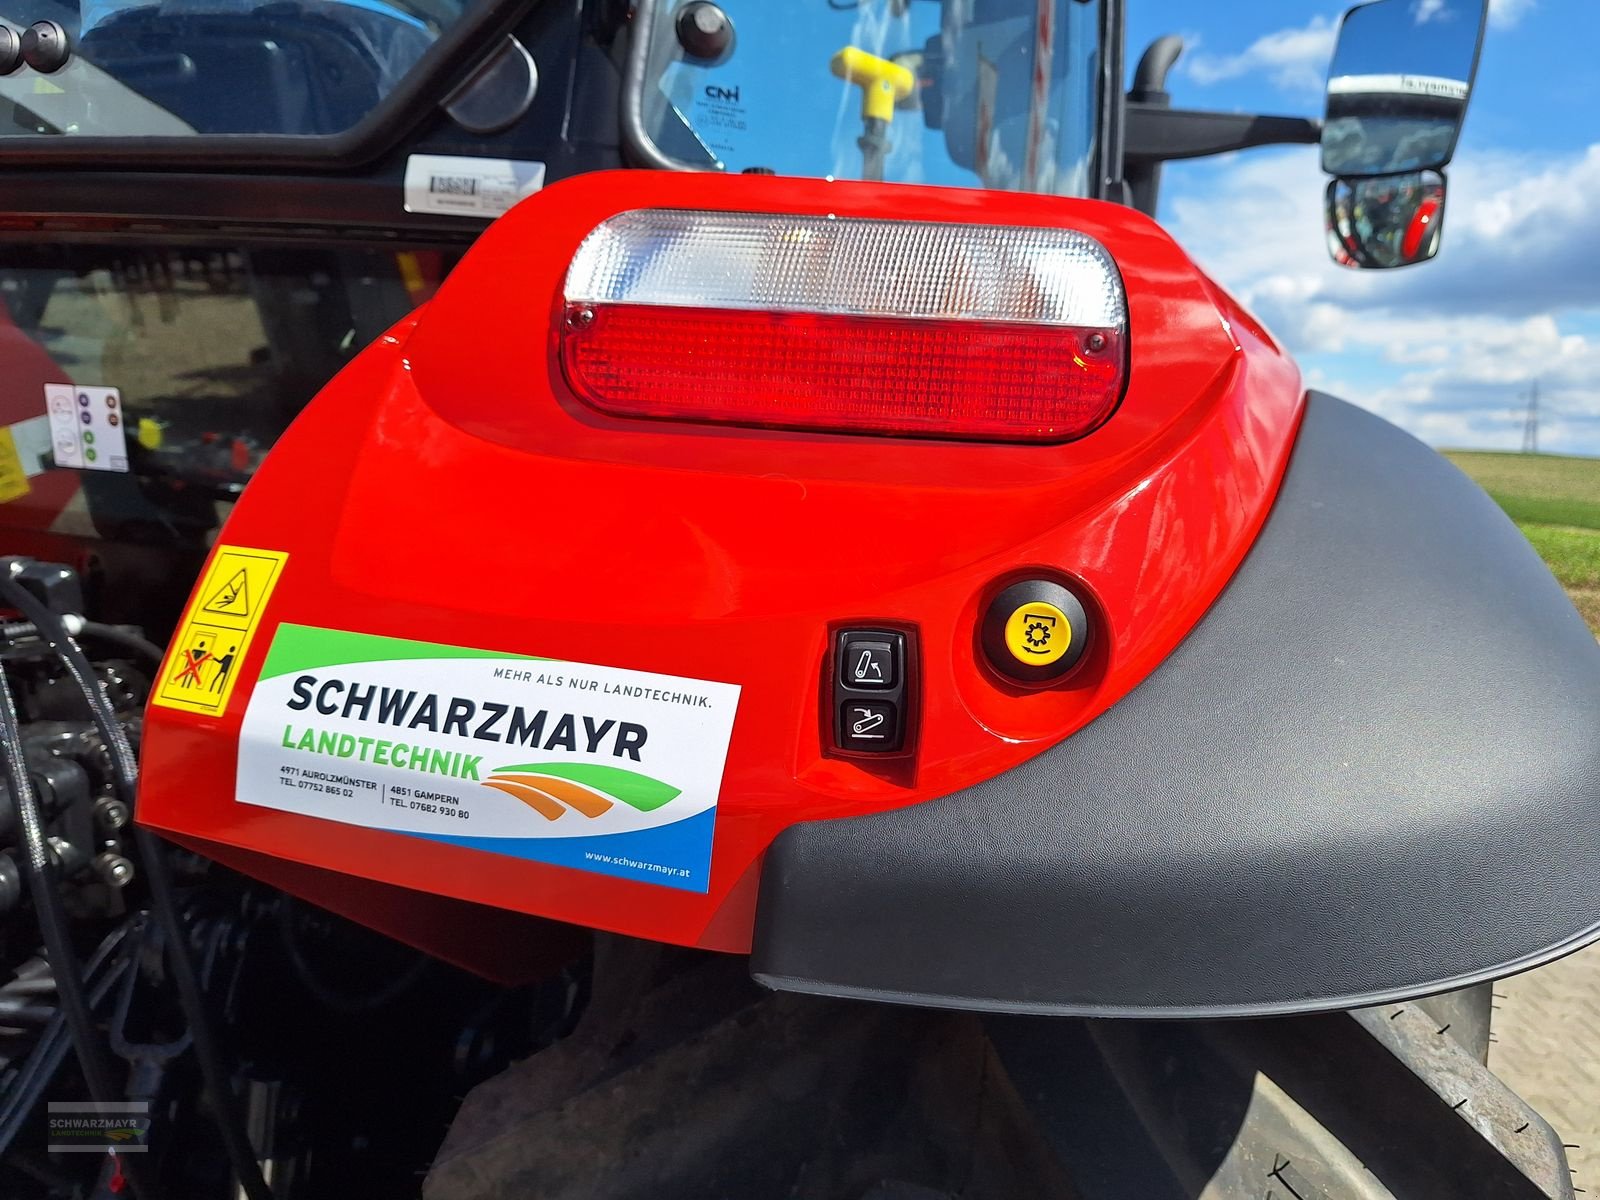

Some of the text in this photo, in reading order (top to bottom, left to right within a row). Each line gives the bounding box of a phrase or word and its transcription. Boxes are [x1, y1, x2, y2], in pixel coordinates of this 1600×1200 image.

[493, 667, 712, 709] MEHR ALS NUR LANDTECHNIK.
[286, 674, 649, 762] SCHWARZMAYR
[281, 724, 484, 781] LANDTECHNIK
[279, 777, 354, 798] TEL. 07752 865 02
[280, 765, 377, 791] 4971 AUROLZMÜNSTER
[389, 797, 470, 820] TEL. 07682 930 80
[390, 785, 460, 806] 4851 GAMPERN
[585, 851, 691, 878] www.schwarzmayr.at
